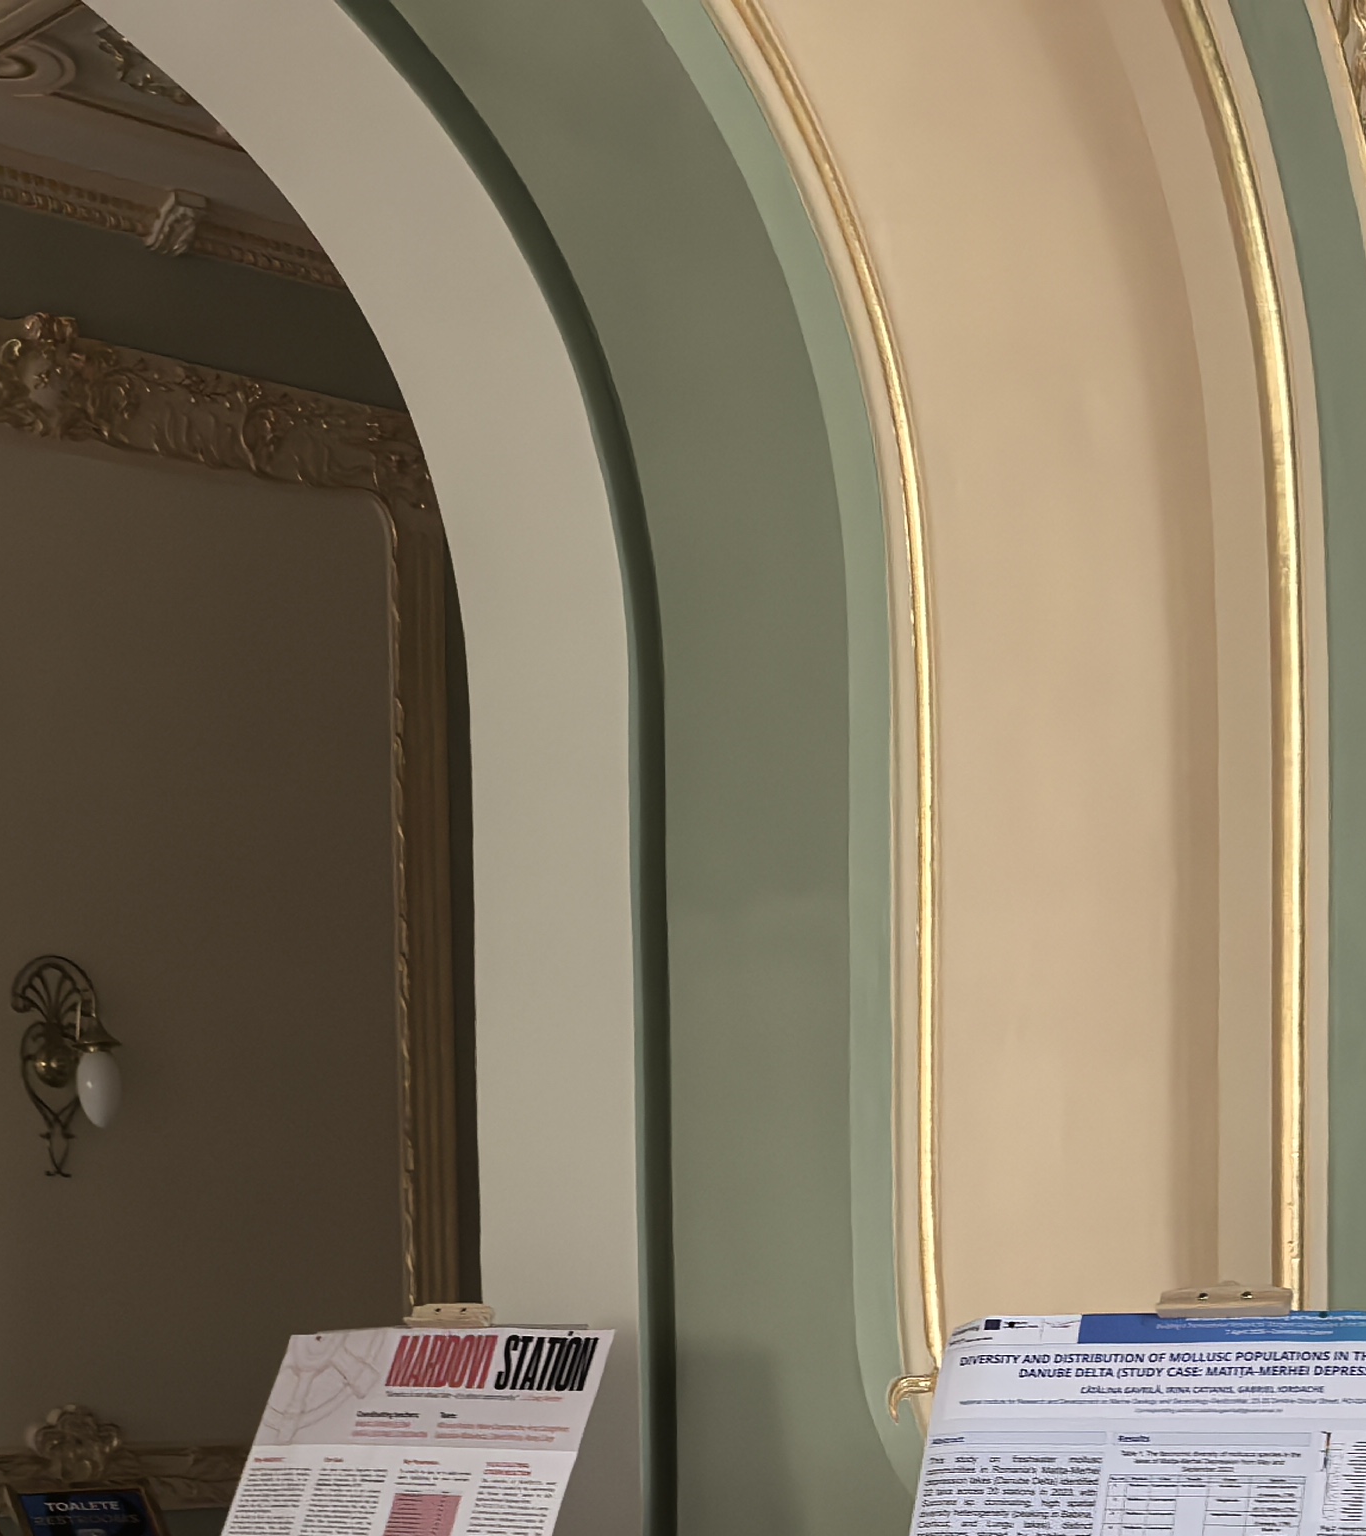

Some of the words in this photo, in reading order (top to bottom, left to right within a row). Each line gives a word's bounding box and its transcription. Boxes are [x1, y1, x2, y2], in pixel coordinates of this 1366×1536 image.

[494, 1331, 599, 1392] STATION
[959, 1354, 1019, 1366] DIVERSITY
[1022, 1353, 1050, 1364] AND
[1053, 1353, 1148, 1364] DISTRIBUTION
[1150, 1352, 1165, 1363] OF
[1169, 1352, 1233, 1362] MOLLUSC
[1235, 1351, 1331, 1362] POPULATIONS
[1334, 1351, 1351, 1362] IN
[1019, 1368, 1073, 1378] DANUBE
[1075, 1367, 1114, 1378] DELTA
[1117, 1367, 1163, 1379] (STUDY
[1167, 1367, 1203, 1378] CASE:
[44, 1501, 120, 1511] TOALETE
